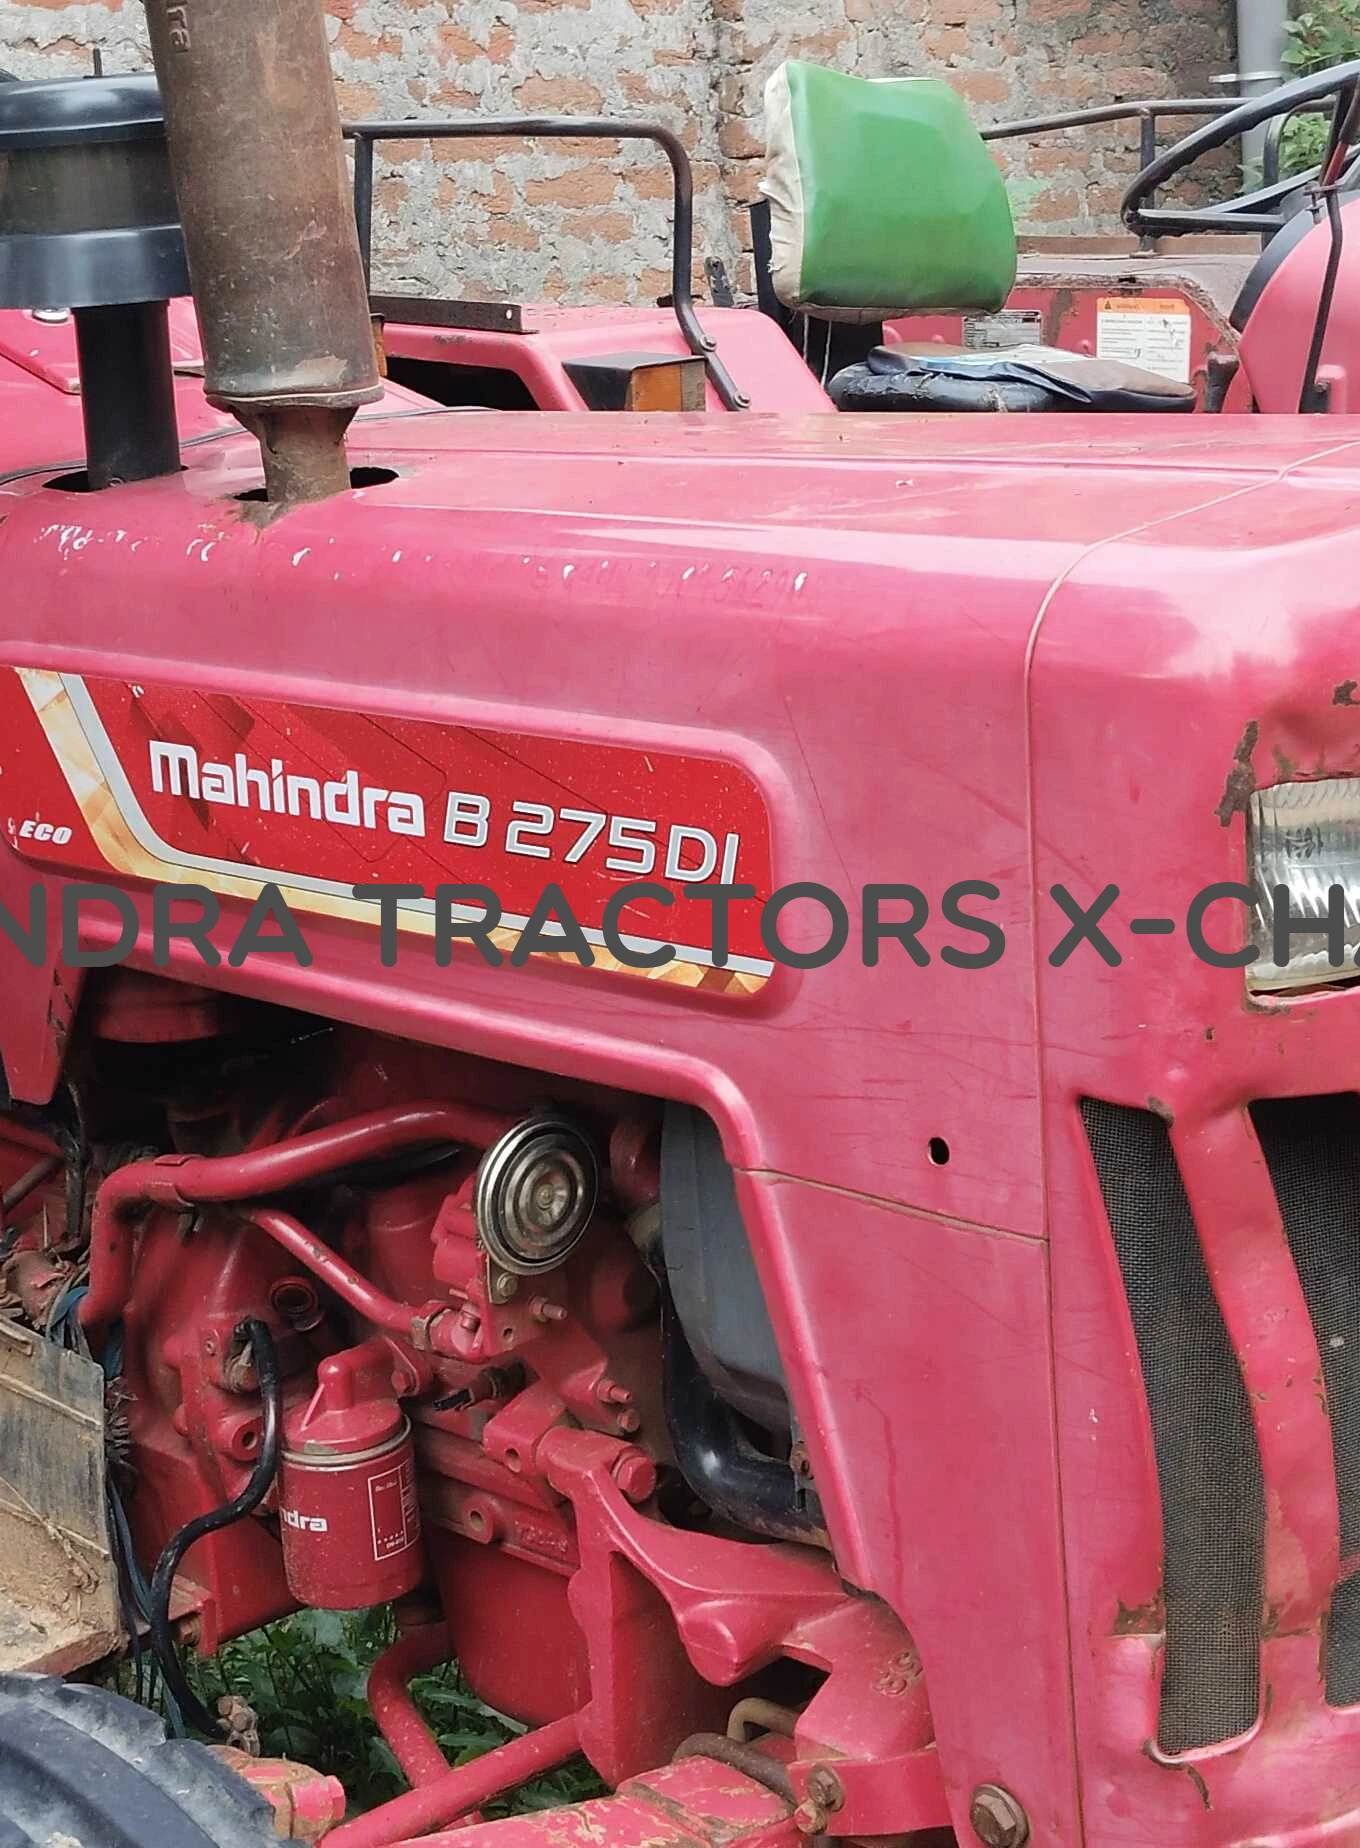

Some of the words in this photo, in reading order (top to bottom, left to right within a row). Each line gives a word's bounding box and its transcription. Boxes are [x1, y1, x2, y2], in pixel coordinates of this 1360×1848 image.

[148, 739, 426, 838] Mahindra
[442, 791, 491, 848] B
[18, 819, 73, 845] ECO
